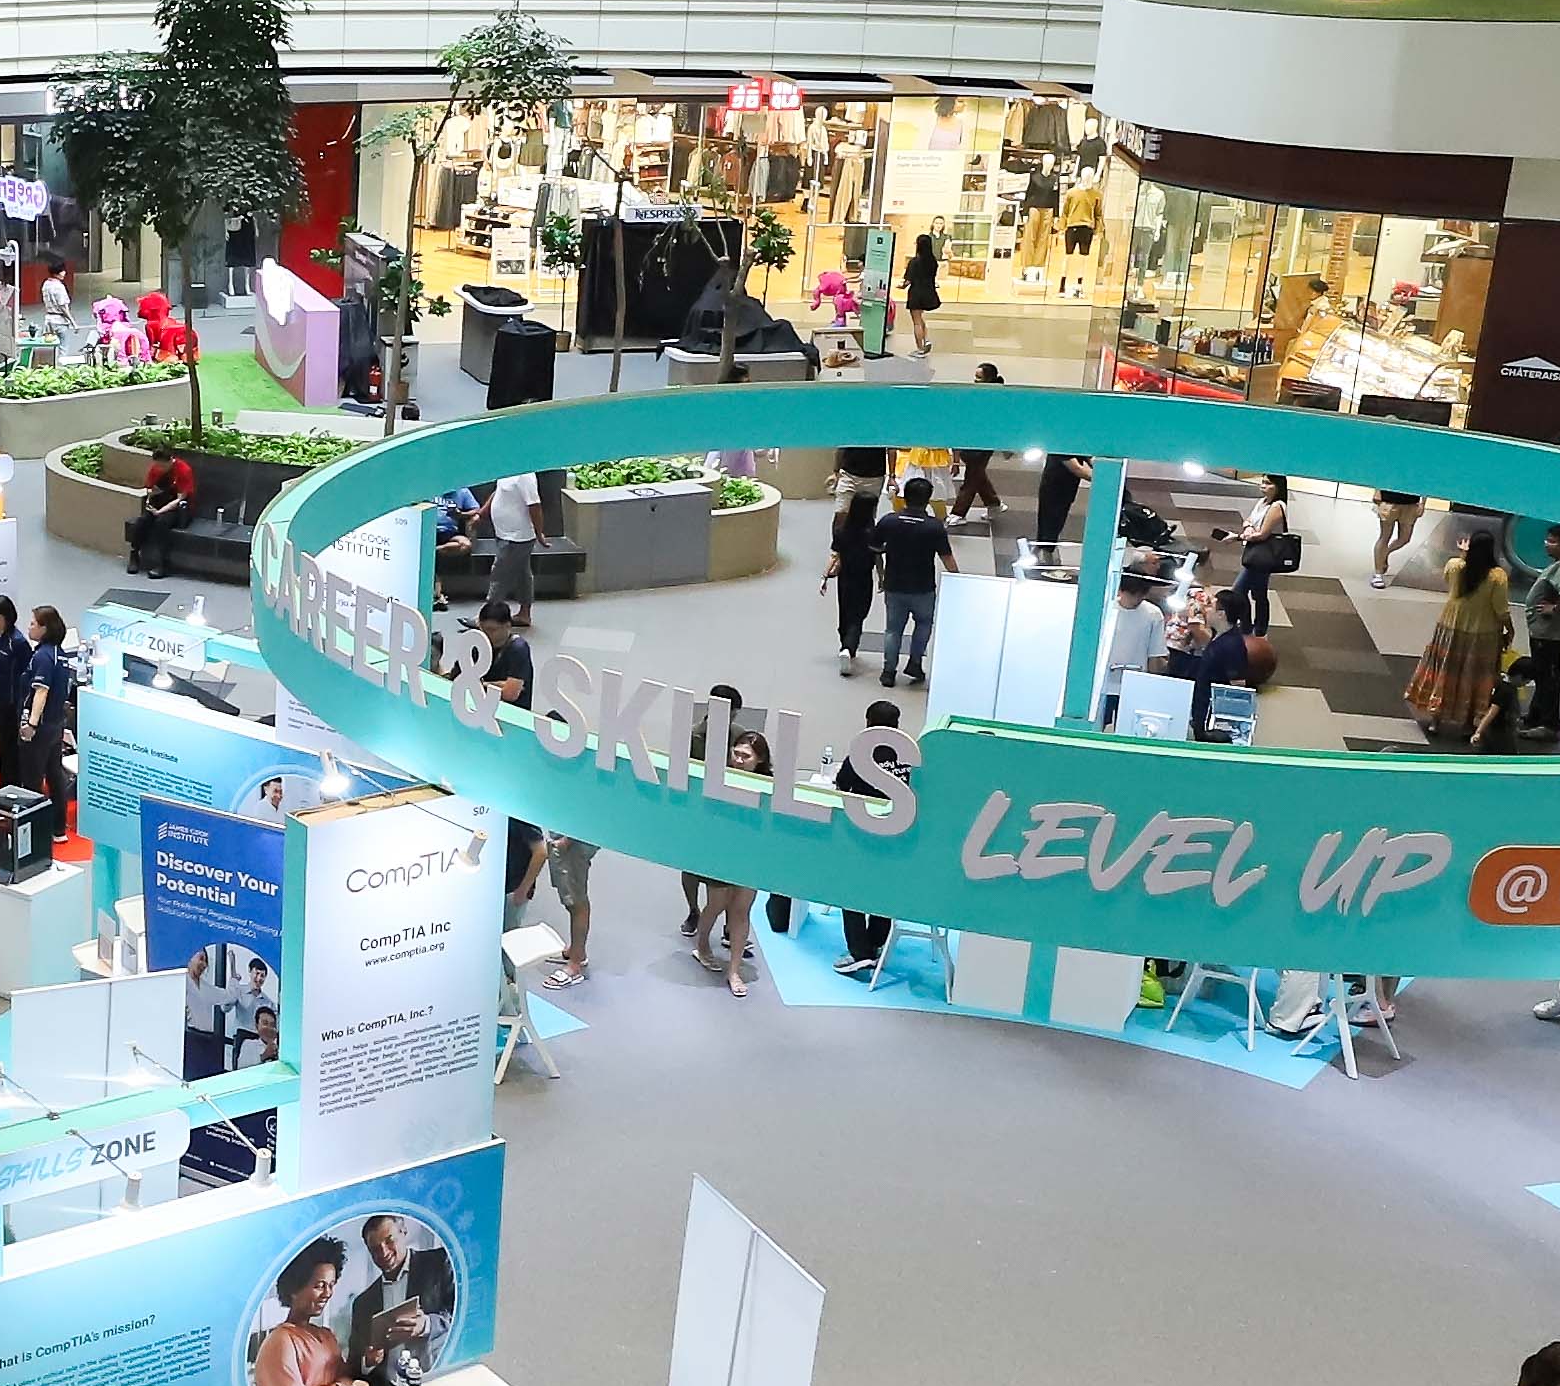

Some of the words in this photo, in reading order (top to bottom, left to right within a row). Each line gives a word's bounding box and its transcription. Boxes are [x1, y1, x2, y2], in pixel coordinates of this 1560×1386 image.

[771, 95, 801, 108] QLO
[261, 521, 431, 708] CAREER
[449, 629, 503, 738] &
[534, 654, 921, 836] SKILLS
[960, 786, 1264, 911] LEVEL
[1296, 827, 1457, 918] UP
[156, 851, 233, 884] Discover
[237, 870, 278, 896] Your
[156, 873, 236, 906] Potential
[1496, 865, 1547, 913] @
[360, 926, 425, 951] CompTIA
[430, 920, 451, 934] Inc
[364, 942, 445, 967] www.comptia.org
[91, 1131, 156, 1165] ZONE
